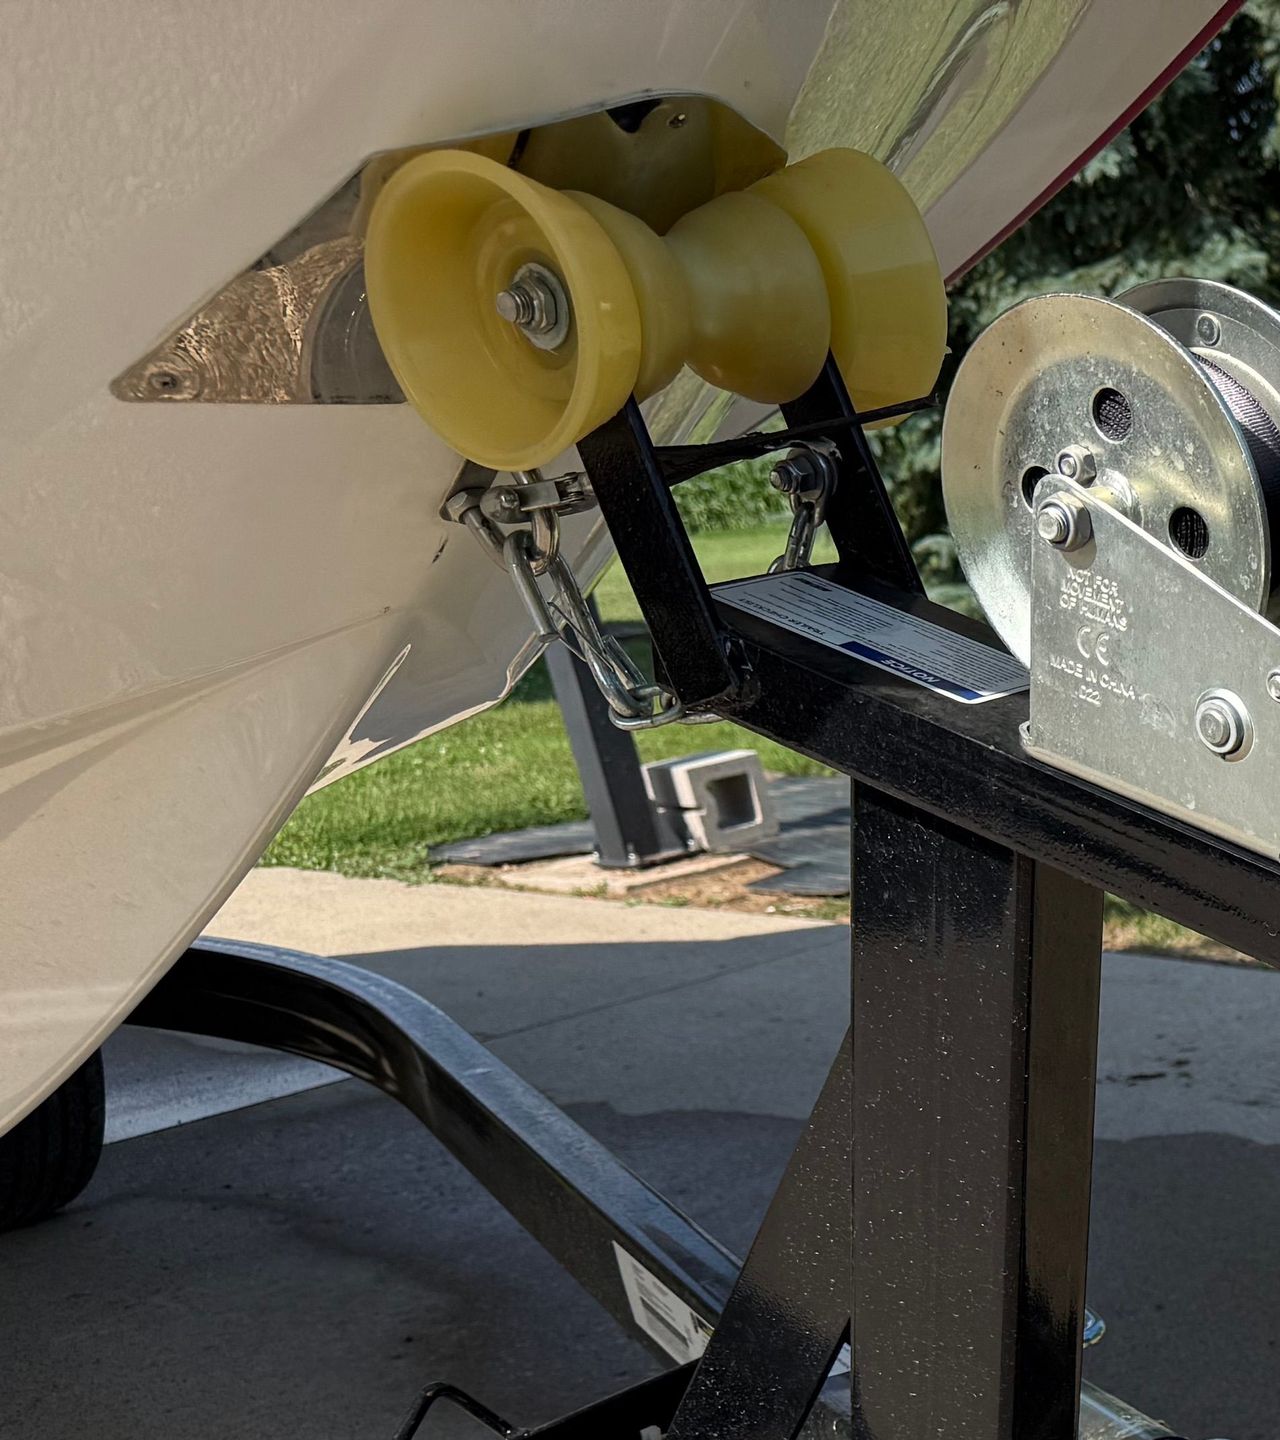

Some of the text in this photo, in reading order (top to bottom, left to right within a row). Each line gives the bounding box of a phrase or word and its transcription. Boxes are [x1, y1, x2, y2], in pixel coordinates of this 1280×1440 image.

[1093, 575, 1118, 597] FOR
[1059, 594, 1078, 609] OF
[881, 658, 941, 683] NOTICE
[1049, 654, 1084, 678] MADE
[1085, 668, 1098, 684] IN
